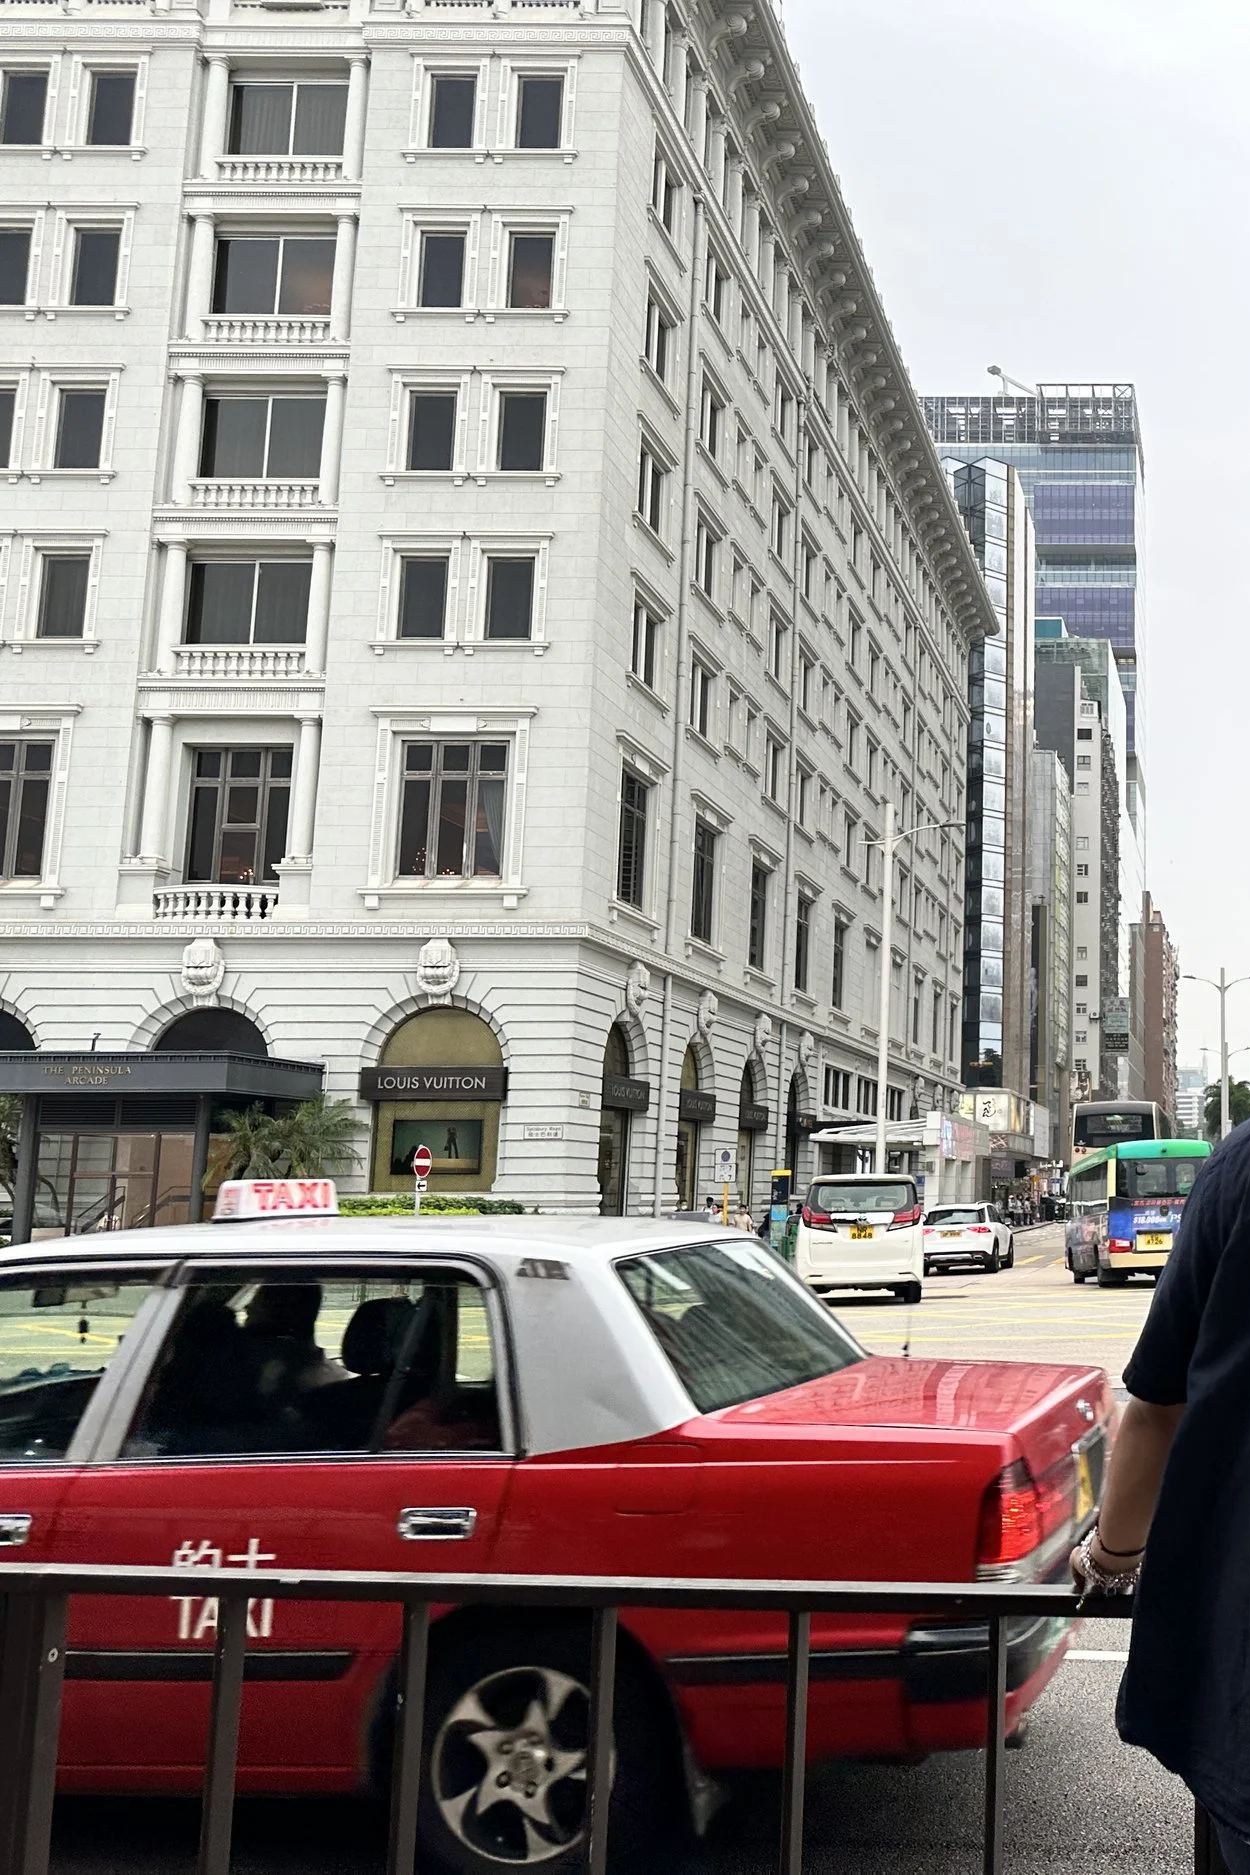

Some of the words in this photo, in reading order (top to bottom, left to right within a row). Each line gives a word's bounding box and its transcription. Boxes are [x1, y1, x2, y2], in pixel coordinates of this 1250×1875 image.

[43, 1066, 64, 1074] THE
[71, 1066, 132, 1074] PENINSULA
[64, 1077, 108, 1085] ARCADE
[377, 1076, 419, 1089] LOUIS
[423, 1076, 486, 1089] VUITTON
[253, 1183, 330, 1210] TAXI
[851, 1232, 873, 1240] 8848
